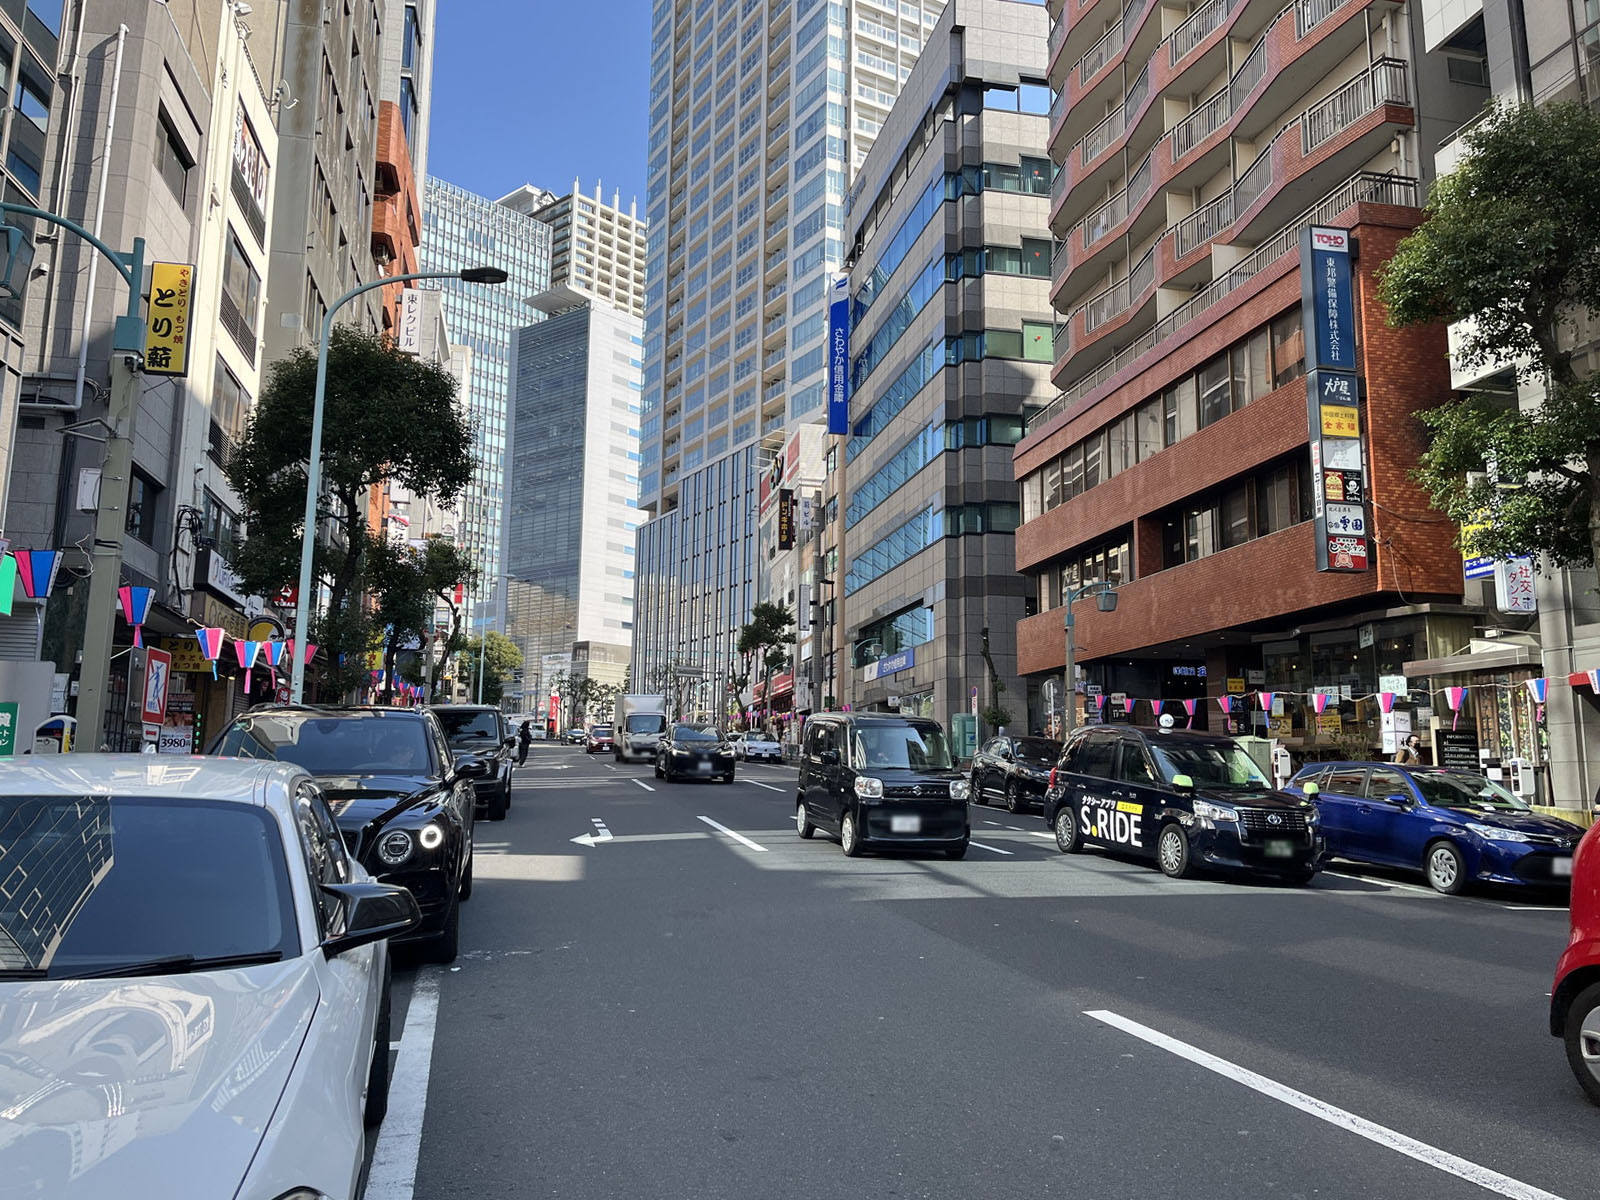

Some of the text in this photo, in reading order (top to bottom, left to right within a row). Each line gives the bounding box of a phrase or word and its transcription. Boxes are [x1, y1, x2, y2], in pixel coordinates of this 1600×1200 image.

[1314, 233, 1345, 246] TOHO
[1326, 257, 1340, 361] 東邦警備保障株式会社
[1324, 377, 1351, 396] 大戸屋
[1508, 572, 1521, 607] ダンス
[1519, 565, 1532, 593] 社交
[1081, 794, 1117, 810] タクシーアプリ
[1080, 805, 1143, 848] S.RIDE
